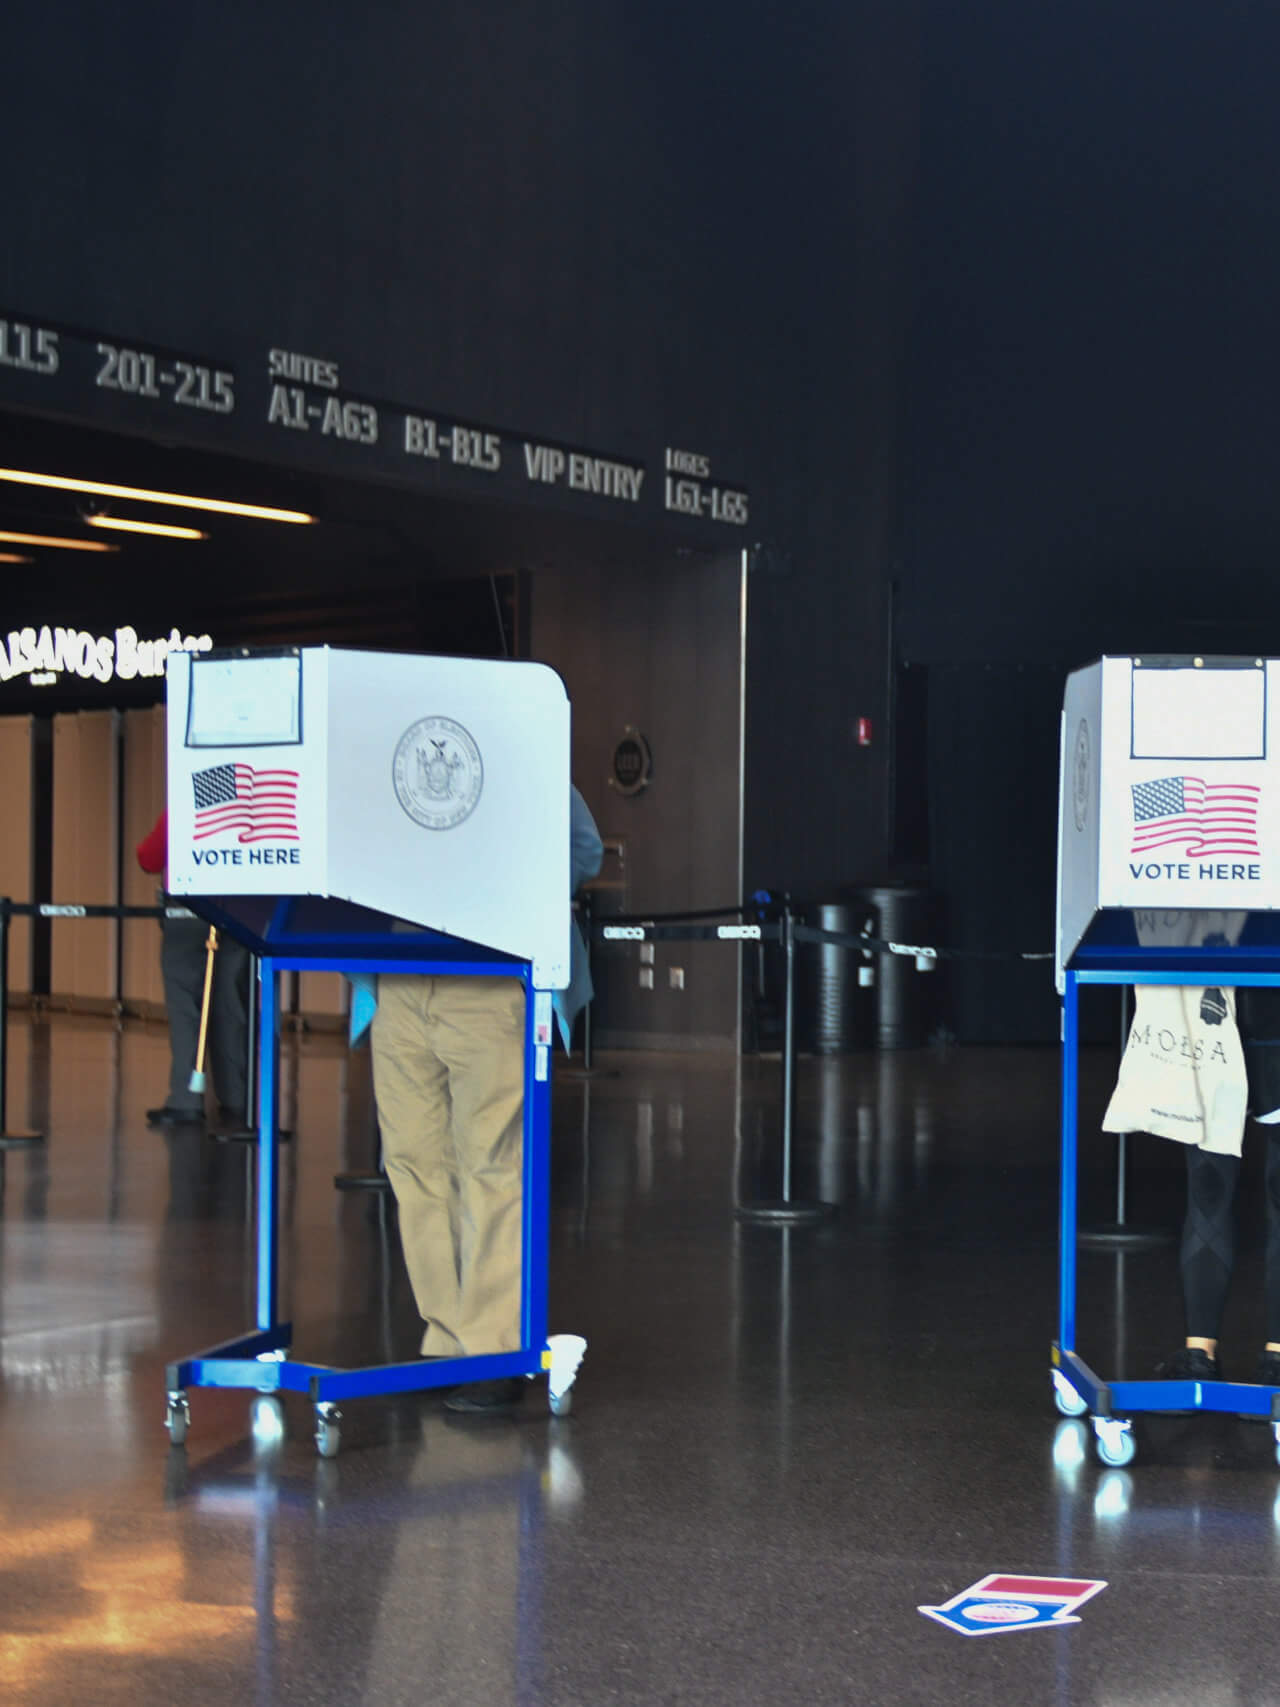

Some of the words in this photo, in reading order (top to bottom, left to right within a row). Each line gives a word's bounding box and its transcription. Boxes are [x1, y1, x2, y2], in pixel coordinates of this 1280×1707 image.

[96, 343, 235, 414] 201-215
[268, 348, 339, 389] SUITES
[267, 385, 379, 444] A1-A63
[405, 414, 500, 471] B1-B15
[666, 447, 710, 478] LOGES
[523, 442, 564, 483] VIP
[569, 453, 645, 501] ENTRY
[192, 849, 243, 866] VOTE
[248, 849, 301, 866] HERE
[1129, 863, 1190, 881] VOTE
[1199, 863, 1261, 881] HERE
